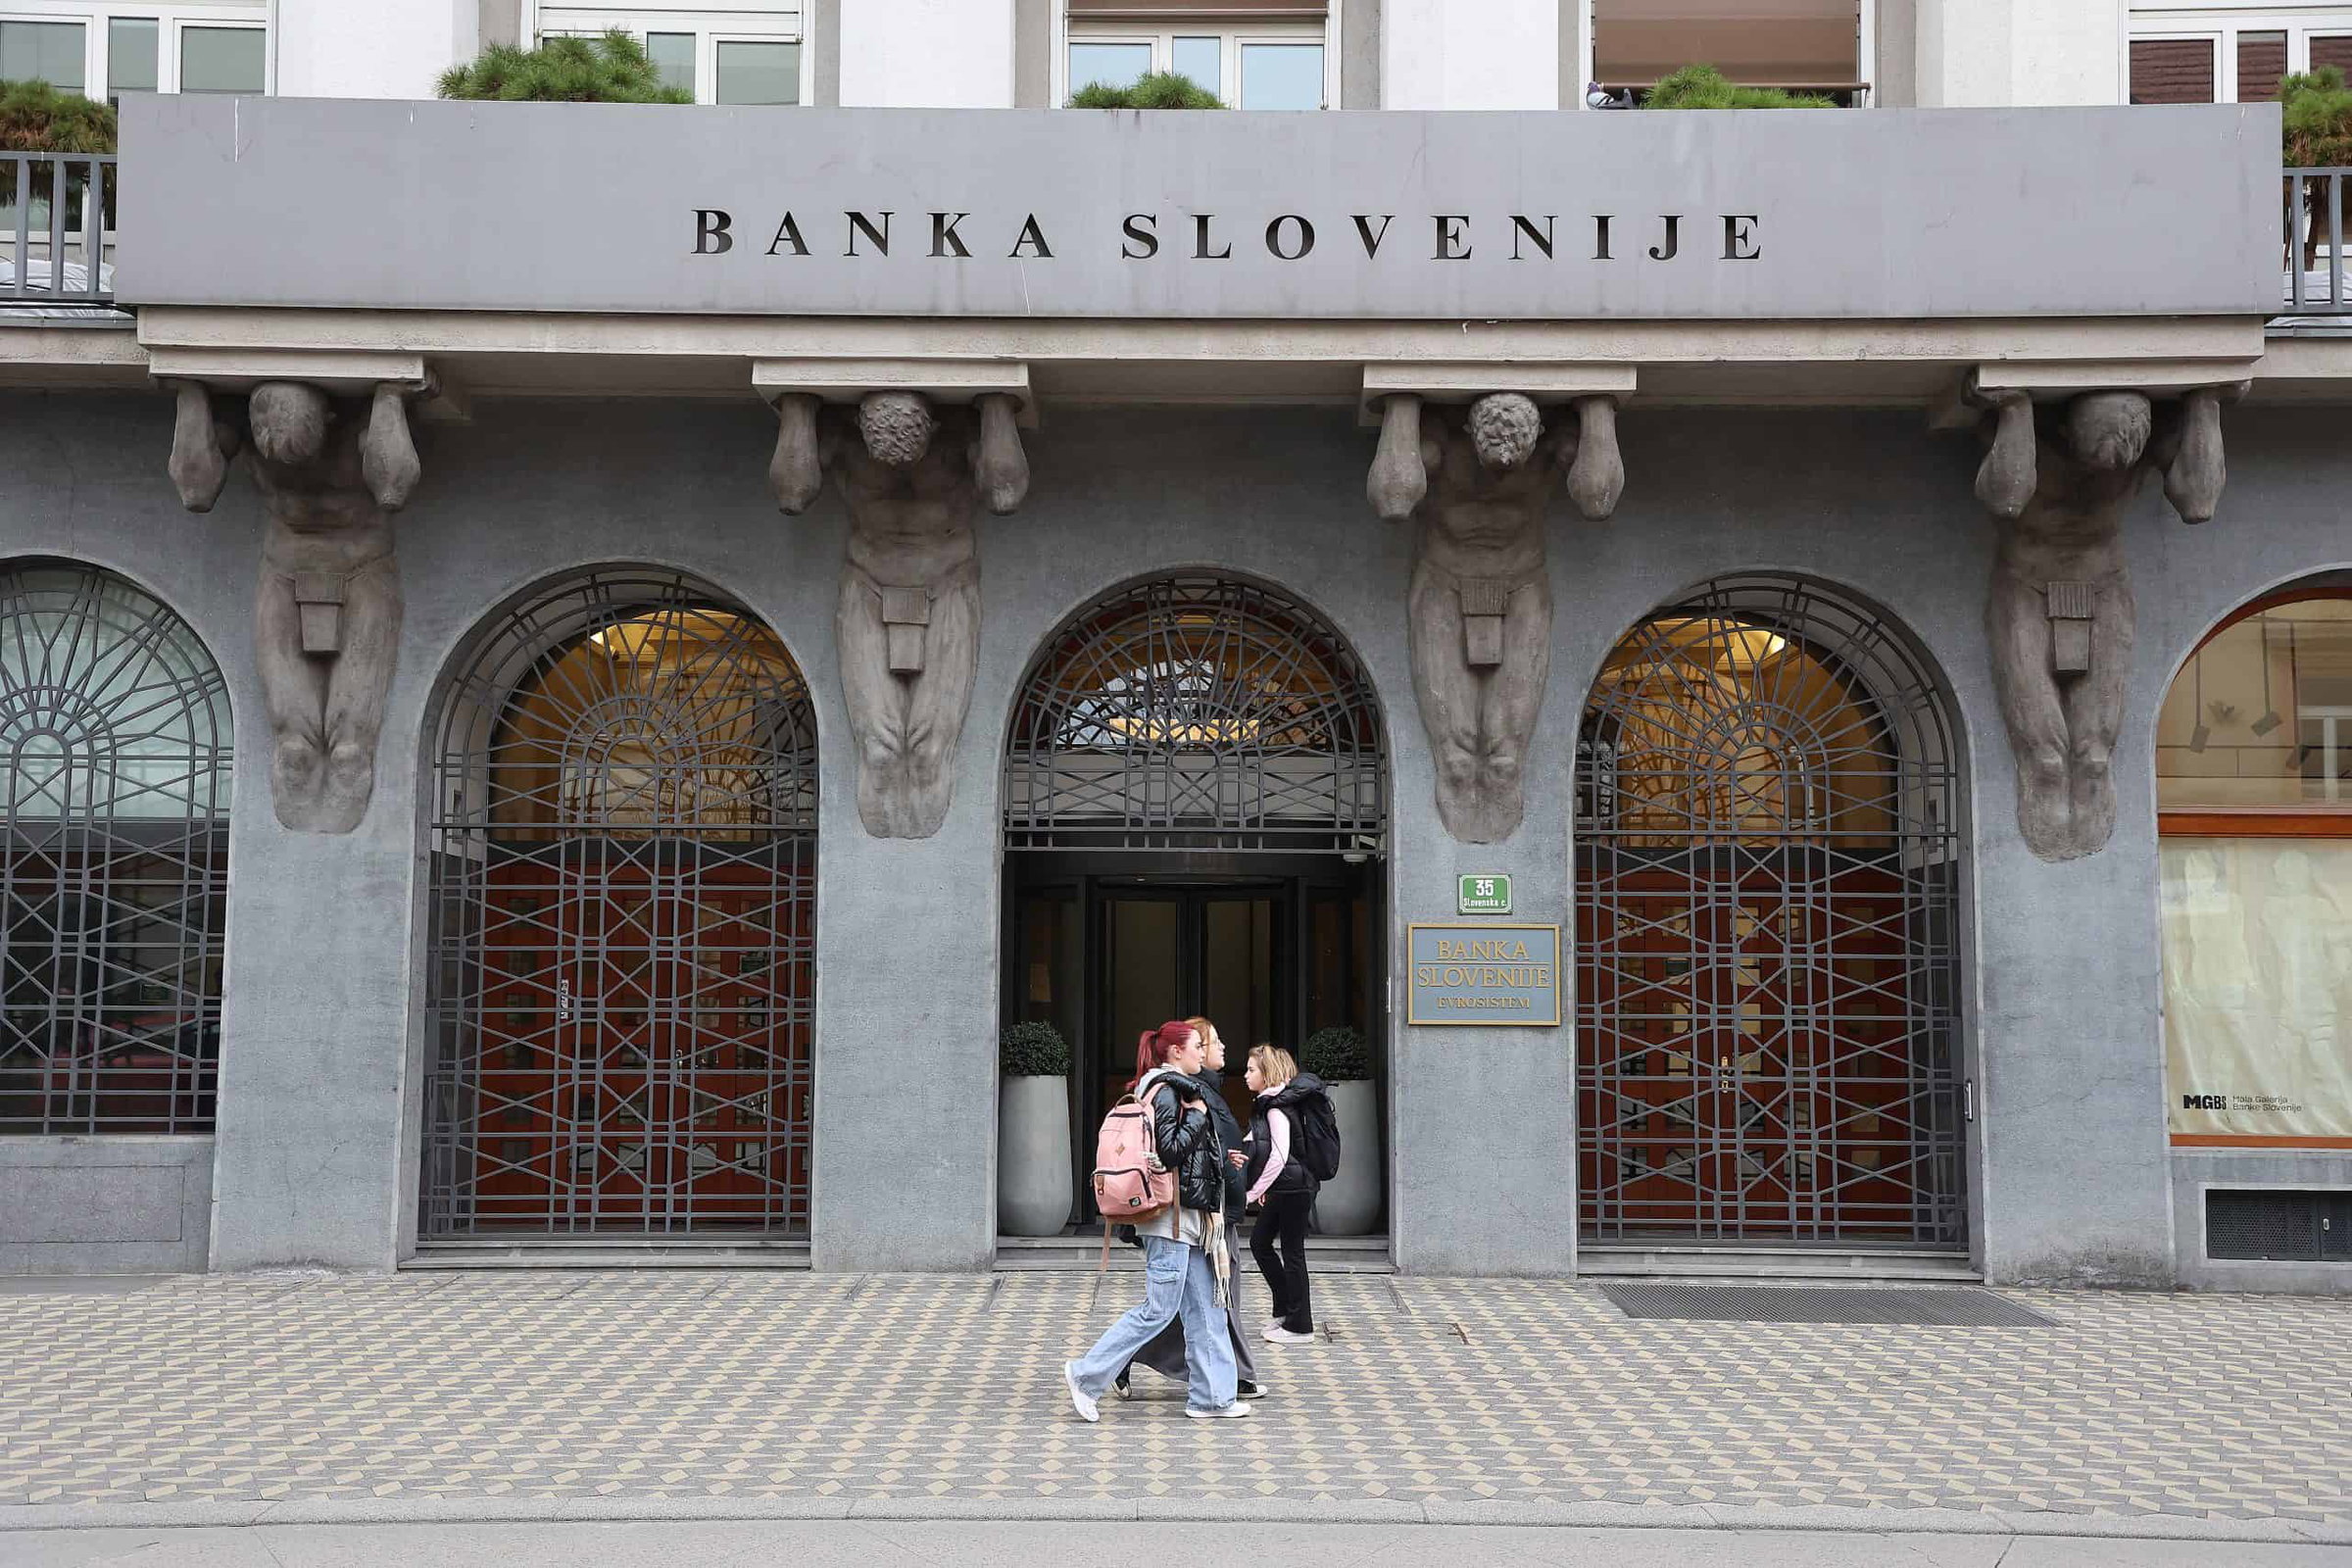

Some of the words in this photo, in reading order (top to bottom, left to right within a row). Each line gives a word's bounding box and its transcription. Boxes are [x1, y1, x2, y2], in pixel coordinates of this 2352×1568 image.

[690, 209, 1054, 259] BANKA
[1121, 214, 1761, 261] SLOVENIJE
[1476, 879, 1494, 896] 35
[1463, 897, 1498, 907] Slovenska
[1437, 940, 1529, 959] BANKA
[1418, 966, 1550, 988] SLOVENIJE
[1438, 997, 1530, 1008] EVROSISTEM
[2182, 1095, 2228, 1110] MGBS
[2263, 1103, 2302, 1113] Slovenije
